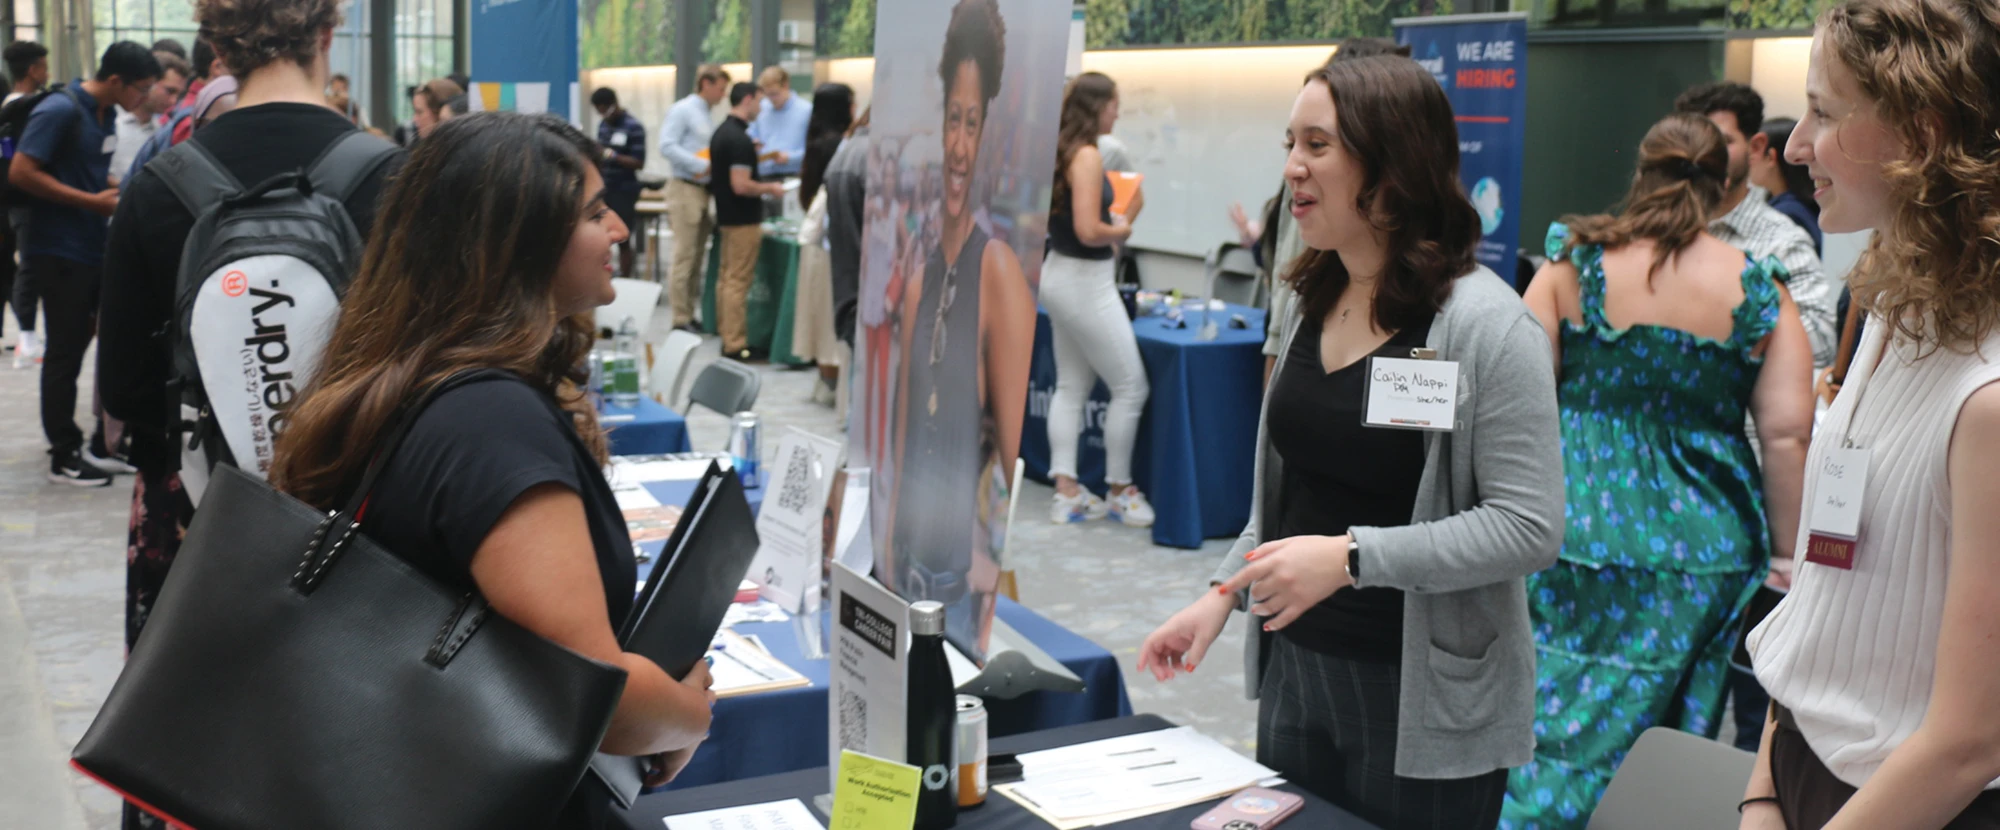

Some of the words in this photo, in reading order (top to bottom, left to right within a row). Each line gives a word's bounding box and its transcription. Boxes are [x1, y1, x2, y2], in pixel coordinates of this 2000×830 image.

[1456, 41, 1482, 62] WE
[1482, 40, 1515, 61] ARE
[1456, 68, 1516, 89] HIRING
[1373, 367, 1407, 383] Cailin
[1412, 372, 1448, 390] Nappi
[1813, 541, 1849, 560] ALUMNI
[854, 606, 894, 639] TRI-COLLEGE
[854, 619, 877, 641] CAREER
[877, 634, 893, 652] FAIR
[847, 777, 865, 786] Work
[861, 789, 895, 802] Accepted
